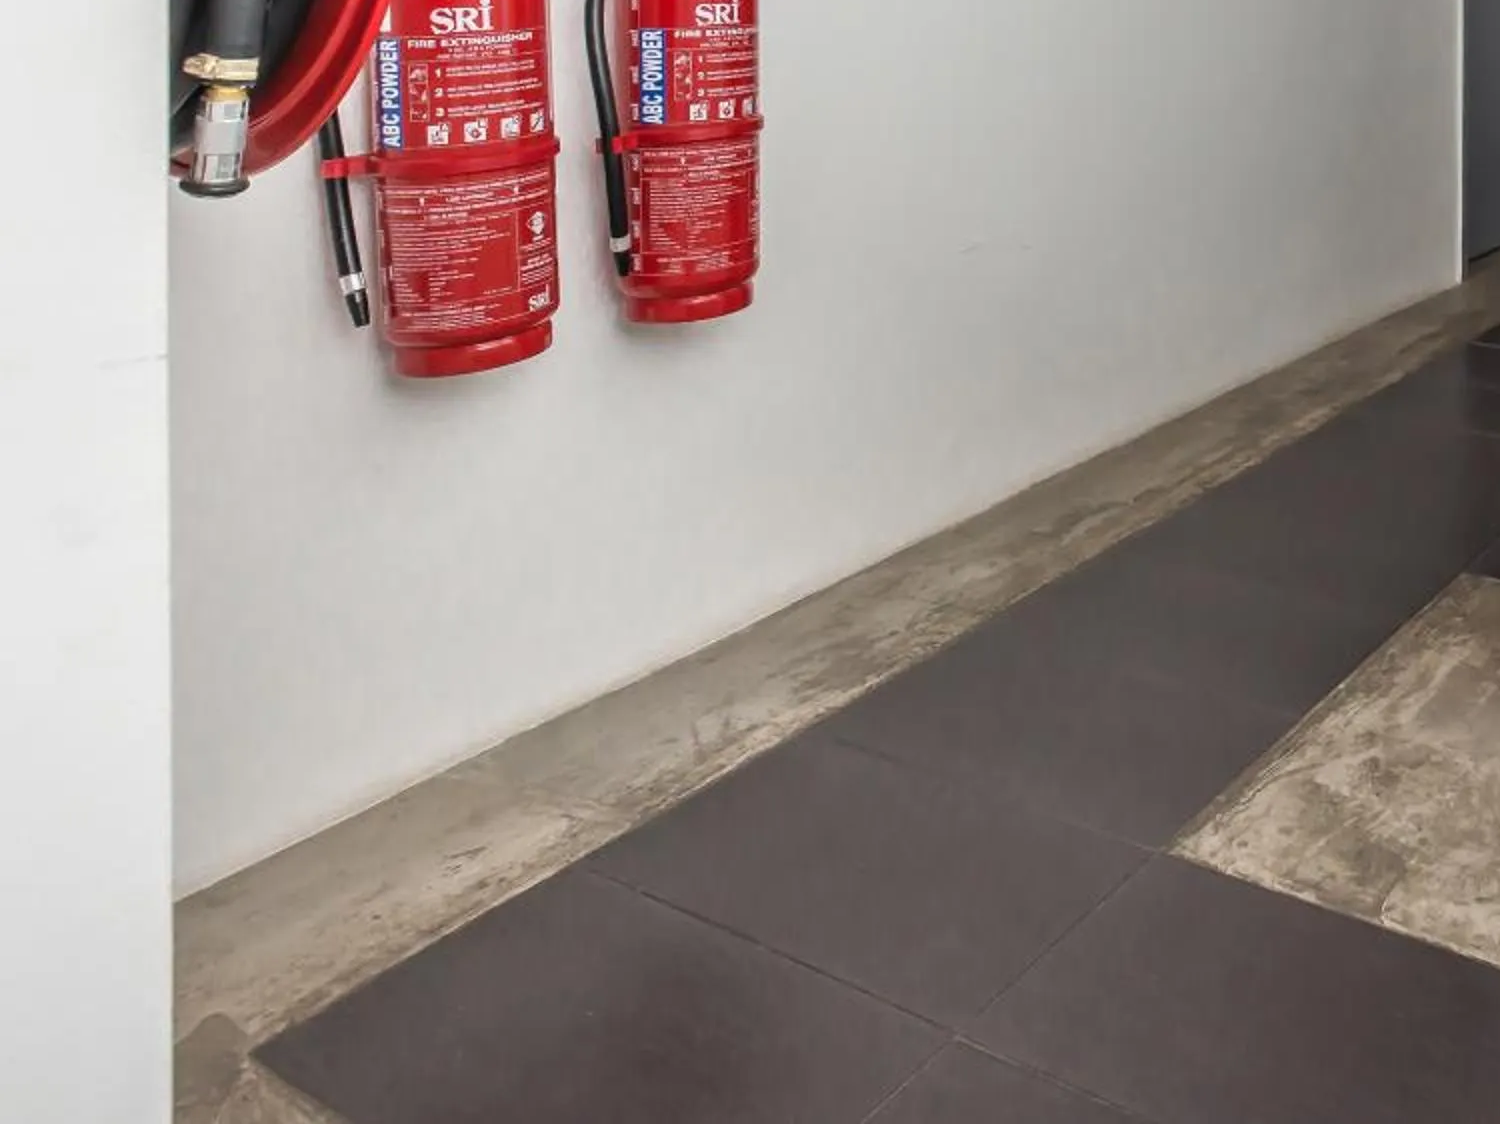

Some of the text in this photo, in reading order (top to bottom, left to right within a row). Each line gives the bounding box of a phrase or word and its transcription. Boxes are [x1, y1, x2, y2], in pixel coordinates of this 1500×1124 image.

[407, 32, 533, 49] FIRE EXTINGUISHER
[641, 30, 664, 124] ABC POWDER
[379, 38, 402, 148] ABC POWDER
